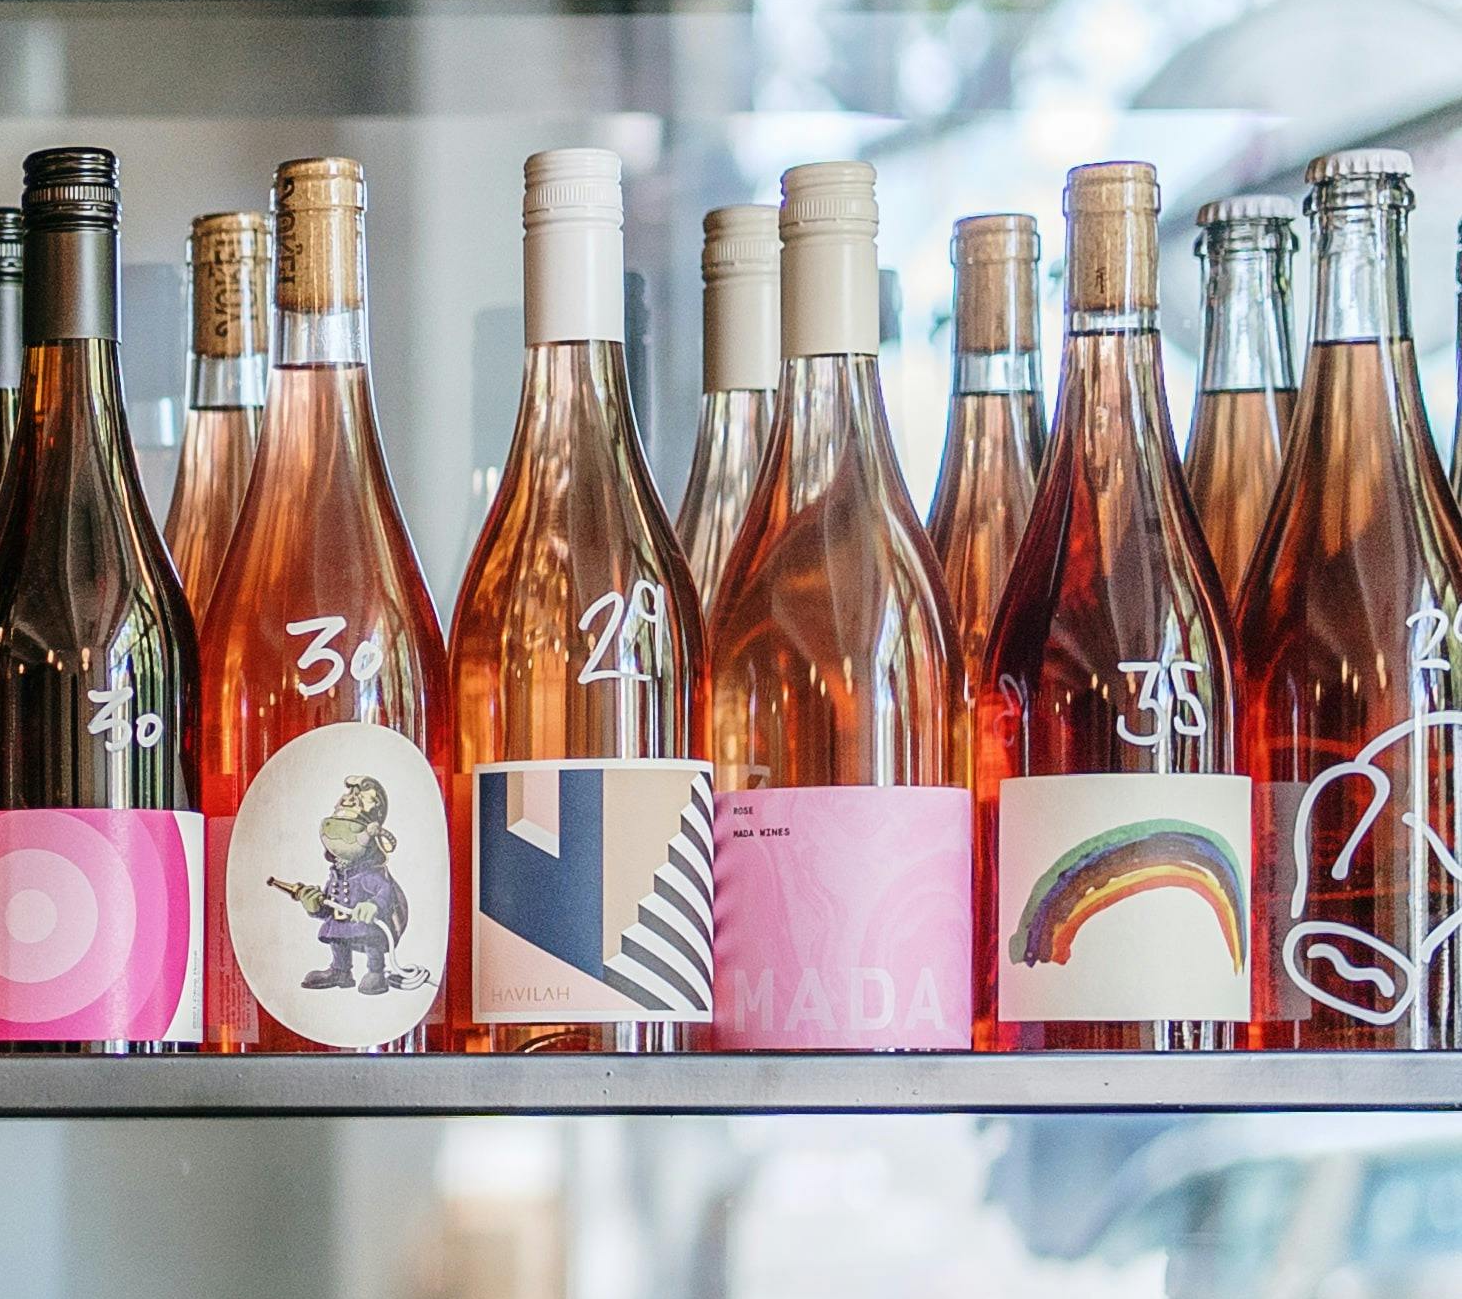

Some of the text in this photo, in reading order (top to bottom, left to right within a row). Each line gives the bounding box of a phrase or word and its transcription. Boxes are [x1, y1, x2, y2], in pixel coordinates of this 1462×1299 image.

[286, 615, 383, 697] 30
[578, 579, 665, 686] 29
[87, 686, 163, 753] 30
[1116, 661, 1206, 751] 35
[733, 806, 754, 815] ROSE
[733, 828, 790, 838] MADA WINES
[491, 986, 570, 1004] HAVILAH
[735, 965, 945, 1035] MADA
